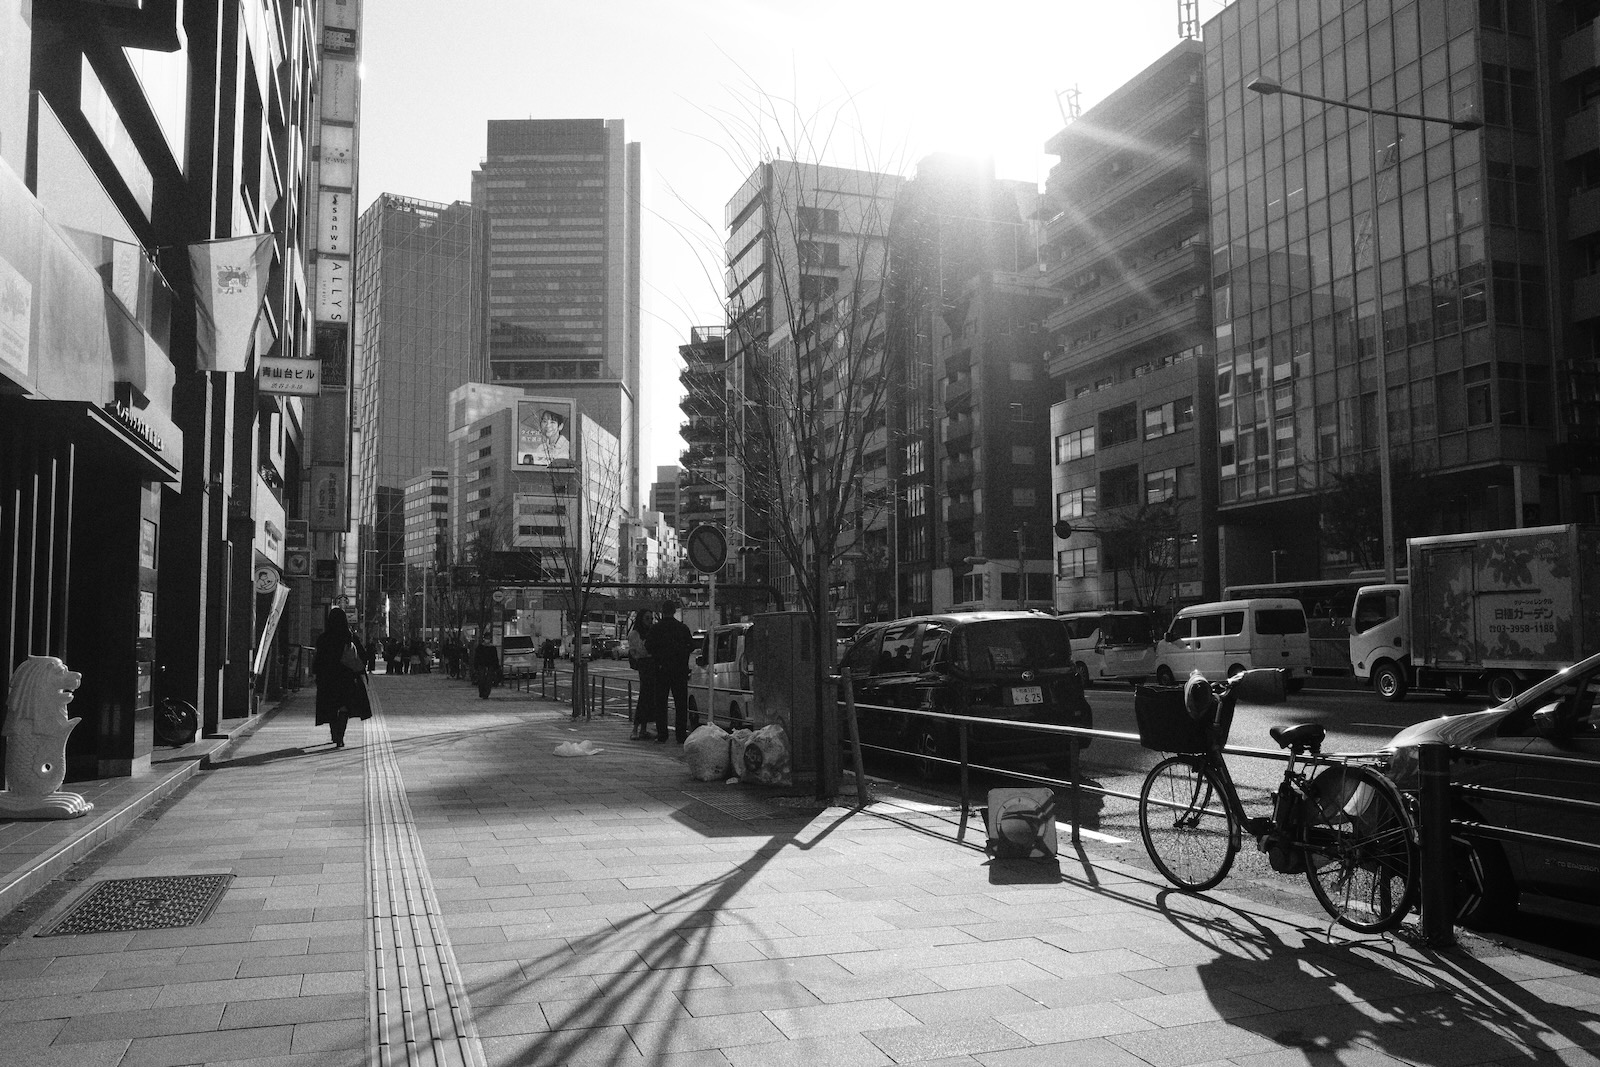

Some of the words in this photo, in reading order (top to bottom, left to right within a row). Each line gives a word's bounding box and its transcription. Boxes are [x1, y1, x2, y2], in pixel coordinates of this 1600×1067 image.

[330, 206, 341, 250] sanwa
[331, 262, 342, 320] ALLYS
[263, 367, 315, 379] 青山台ビル
[1497, 624, 1555, 633] 03-3958-1188
[1567, 862, 1600, 872] Emission
